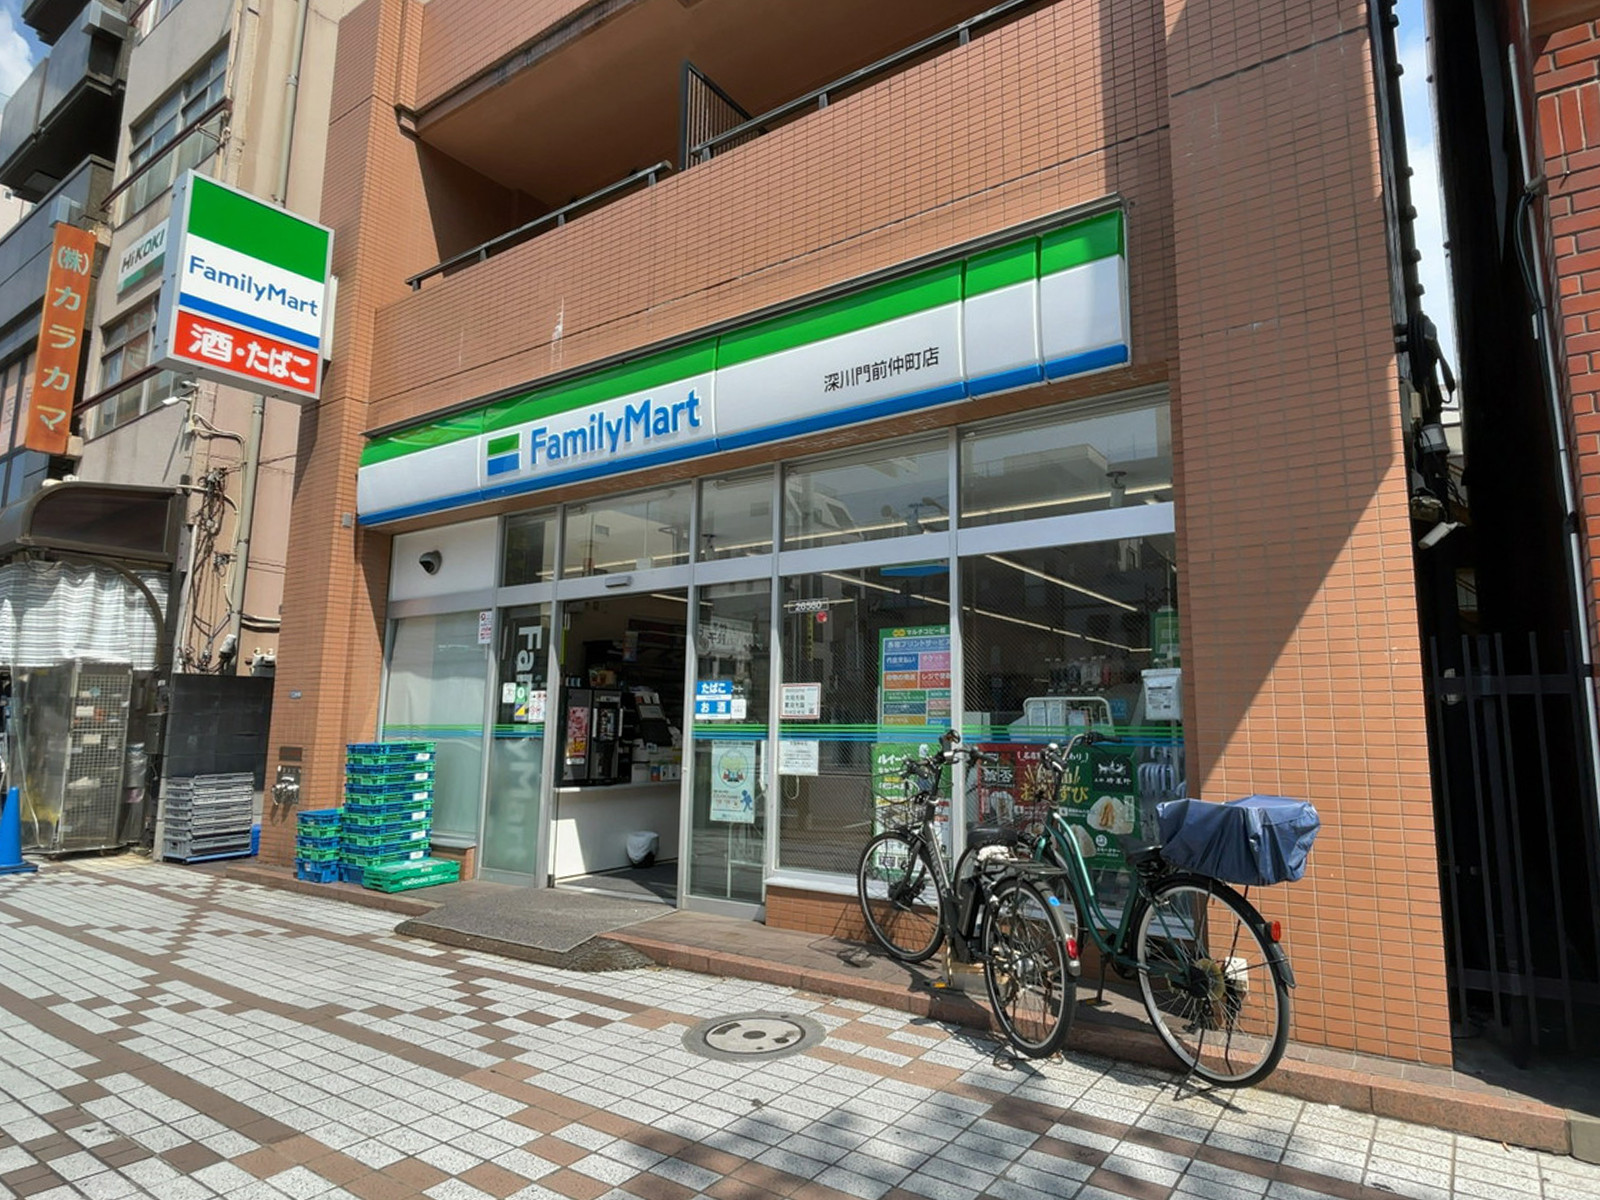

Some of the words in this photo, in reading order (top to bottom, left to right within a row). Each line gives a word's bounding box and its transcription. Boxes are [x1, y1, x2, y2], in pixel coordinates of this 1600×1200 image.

[121, 229, 165, 274] HiKOKI
[188, 256, 319, 317] FamilyMart
[187, 322, 312, 384] 酒・たばこ
[823, 346, 940, 394] 深川門前仲町店
[530, 387, 703, 467] FamilyMart
[701, 682, 726, 694] たばこ
